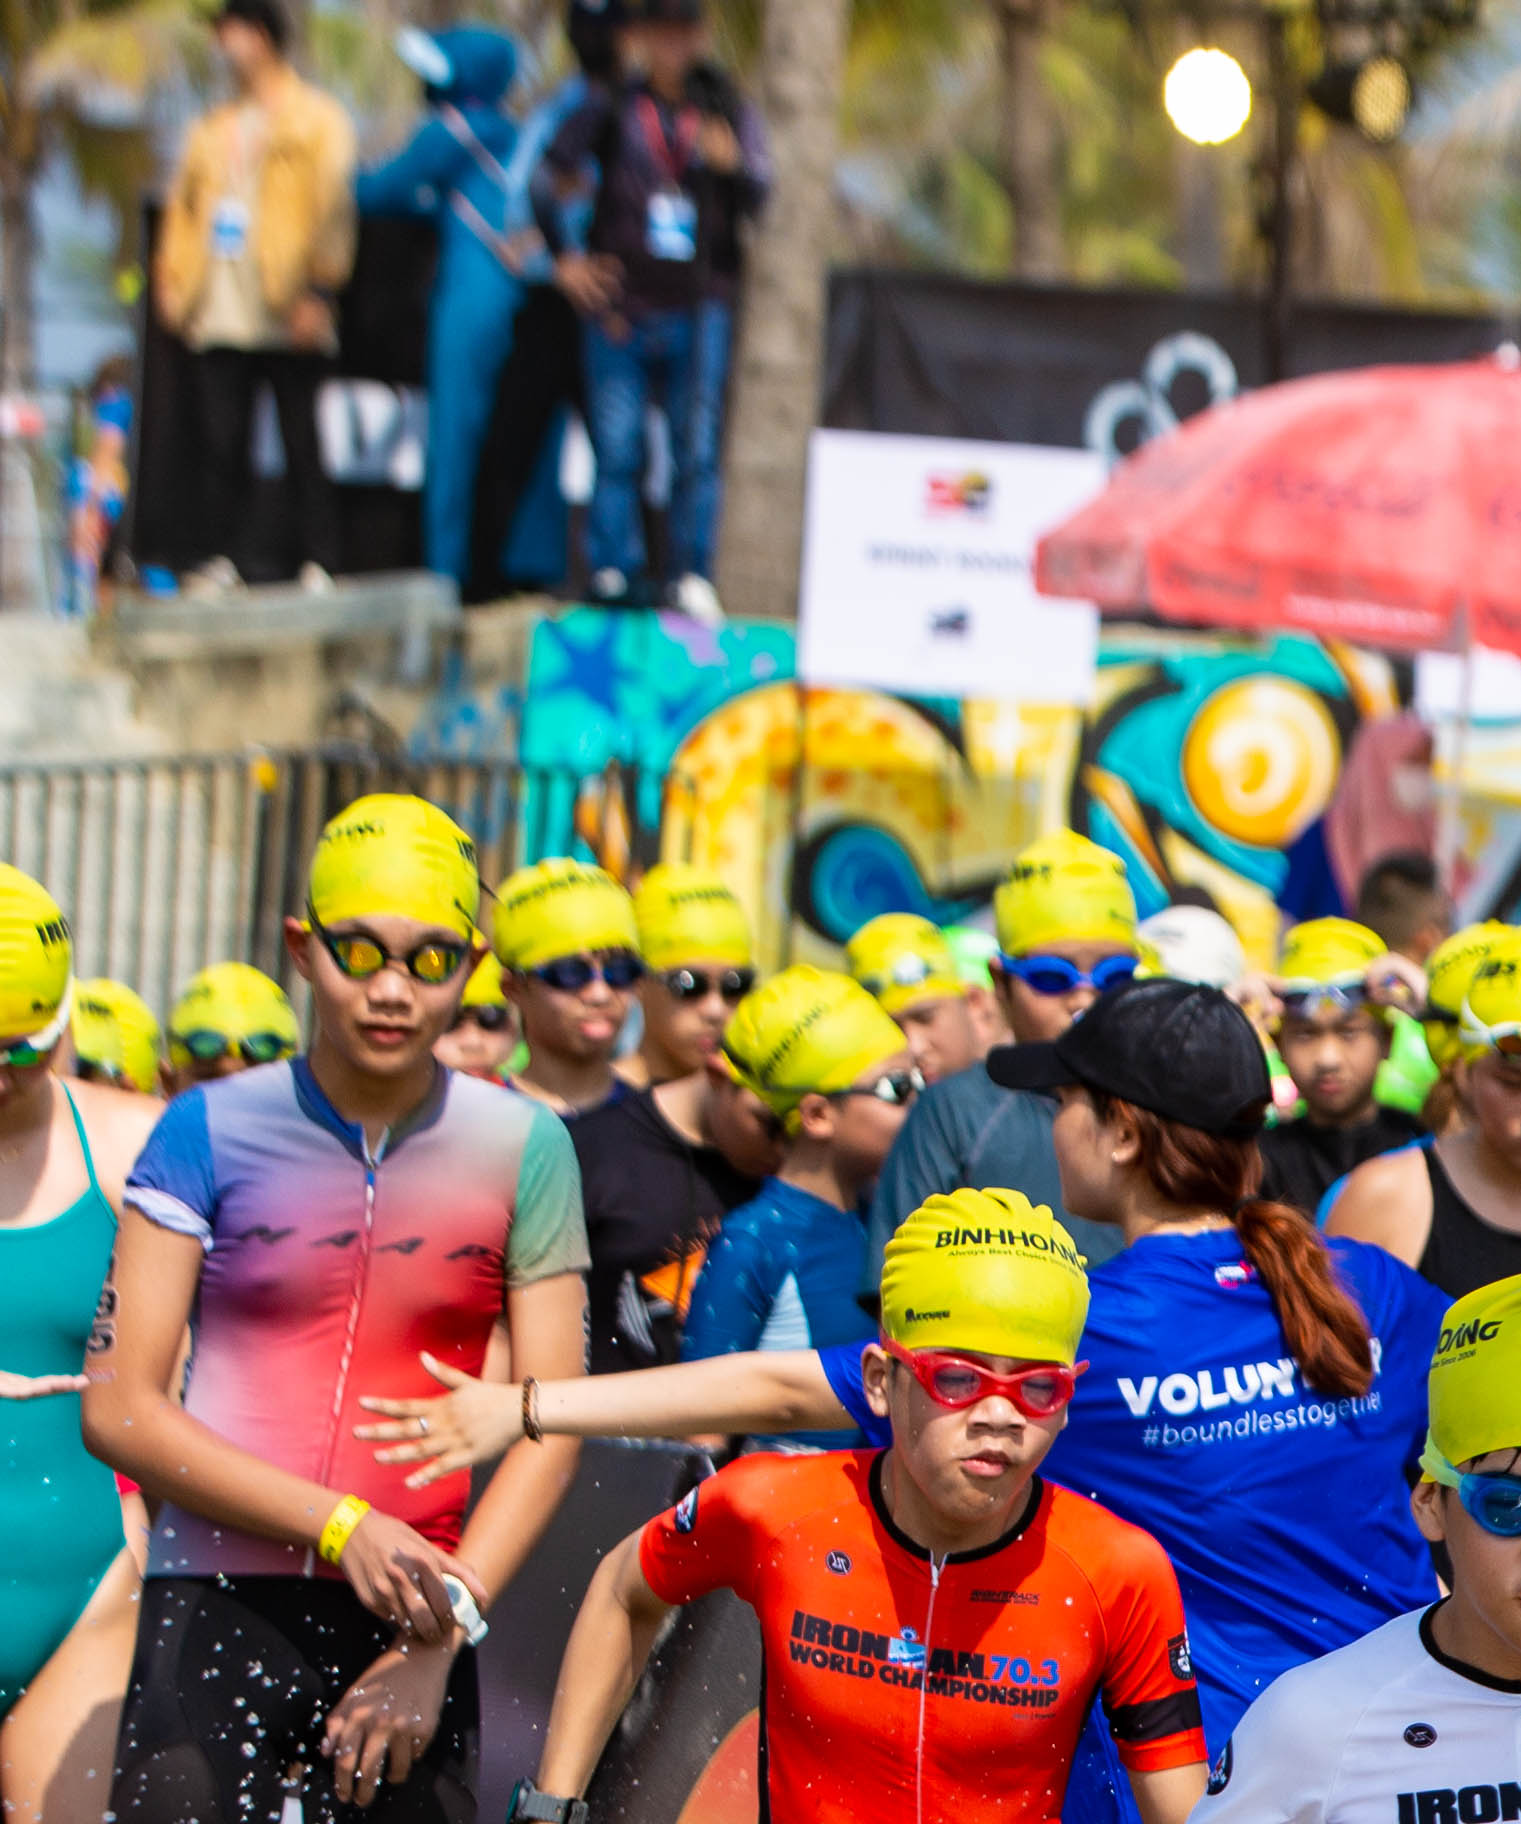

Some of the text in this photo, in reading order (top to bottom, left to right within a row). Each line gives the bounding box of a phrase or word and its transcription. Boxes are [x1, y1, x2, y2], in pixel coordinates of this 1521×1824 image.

[789, 1639, 1060, 1709] WORLD CHAMPIONSHIP
[989, 1654, 1061, 1687] 70.3
